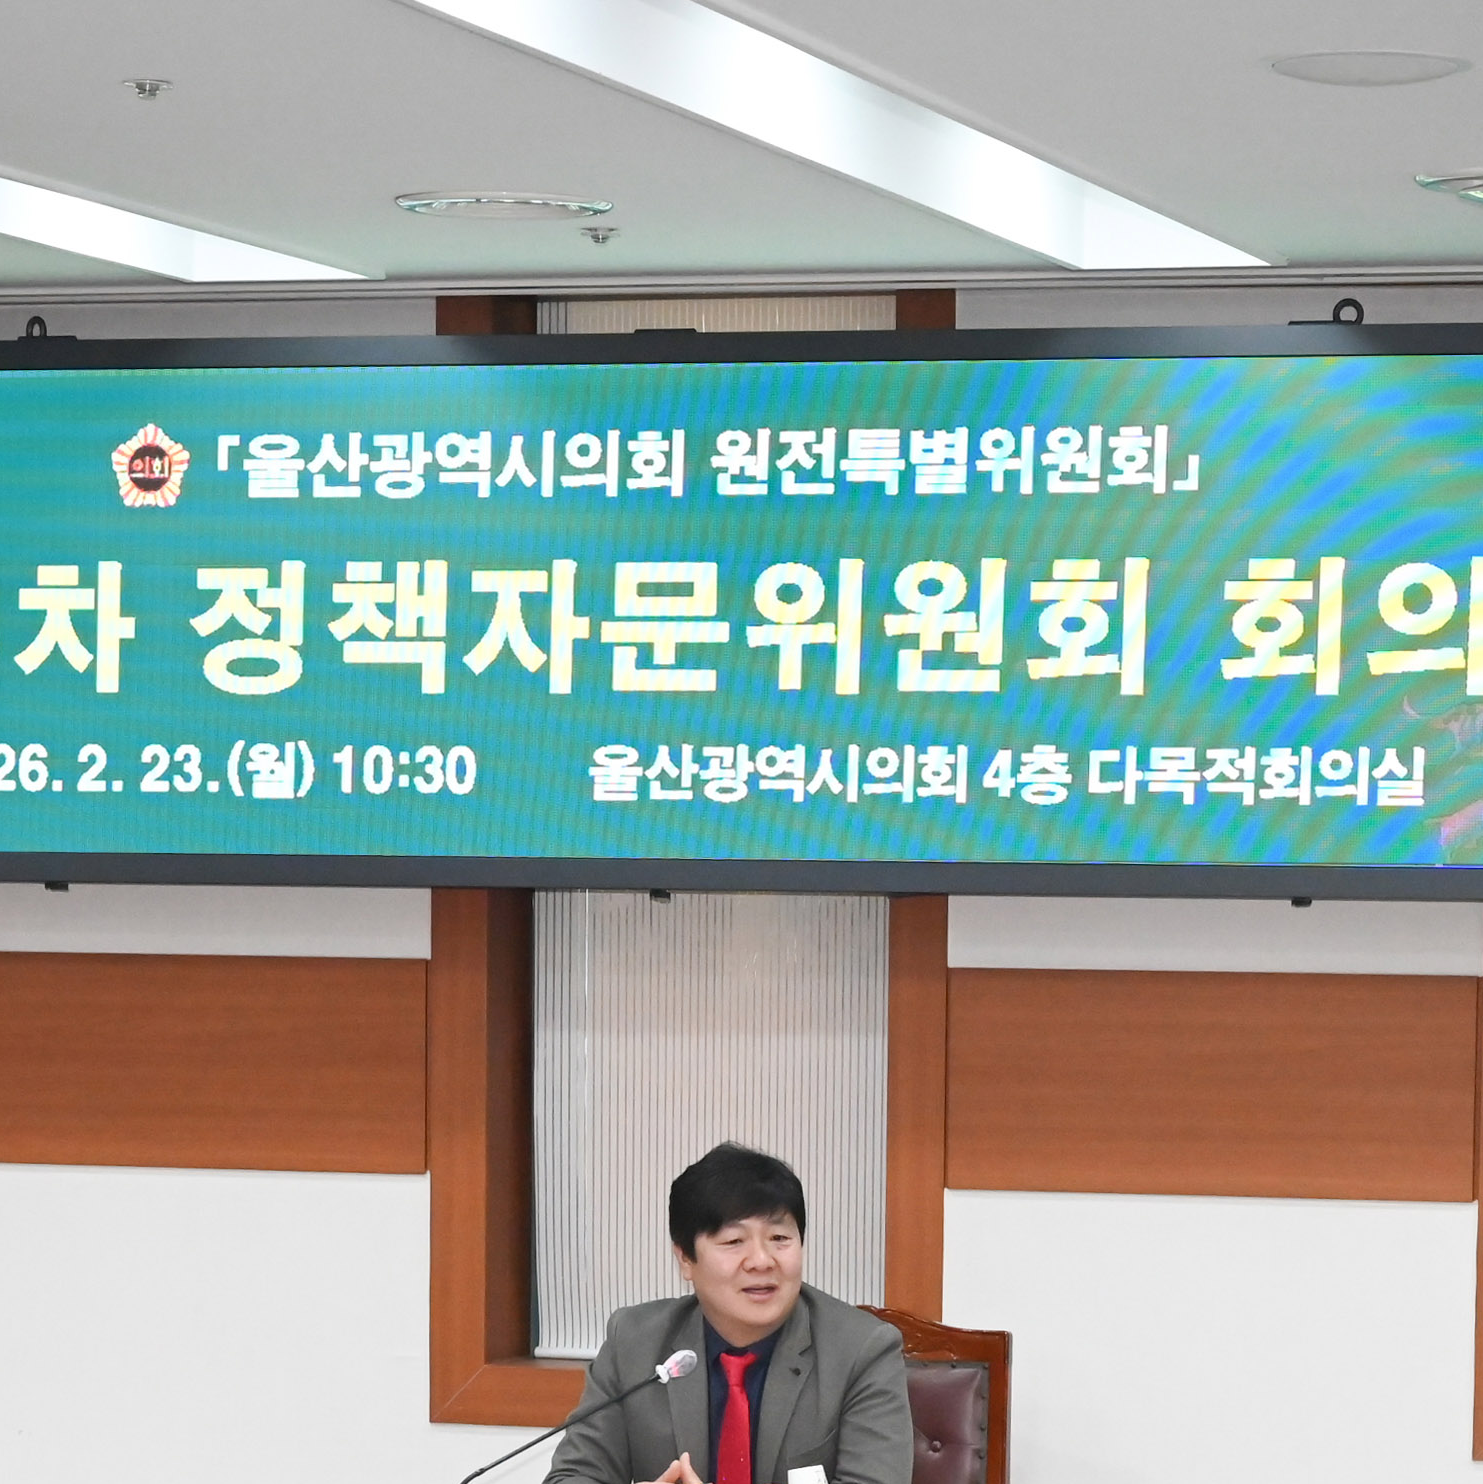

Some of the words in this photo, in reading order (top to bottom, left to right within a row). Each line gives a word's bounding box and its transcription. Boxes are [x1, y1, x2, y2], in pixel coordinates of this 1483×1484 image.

[190, 558, 1149, 695] 정책자문위원회
[78, 745, 122, 791] 2.
[141, 741, 314, 798] 23.(월)
[334, 746, 476, 794] 10:30
[590, 744, 967, 803] 울산광역시의회
[983, 745, 1072, 804] 4층
[1089, 747, 1425, 806] 다목적회의실
